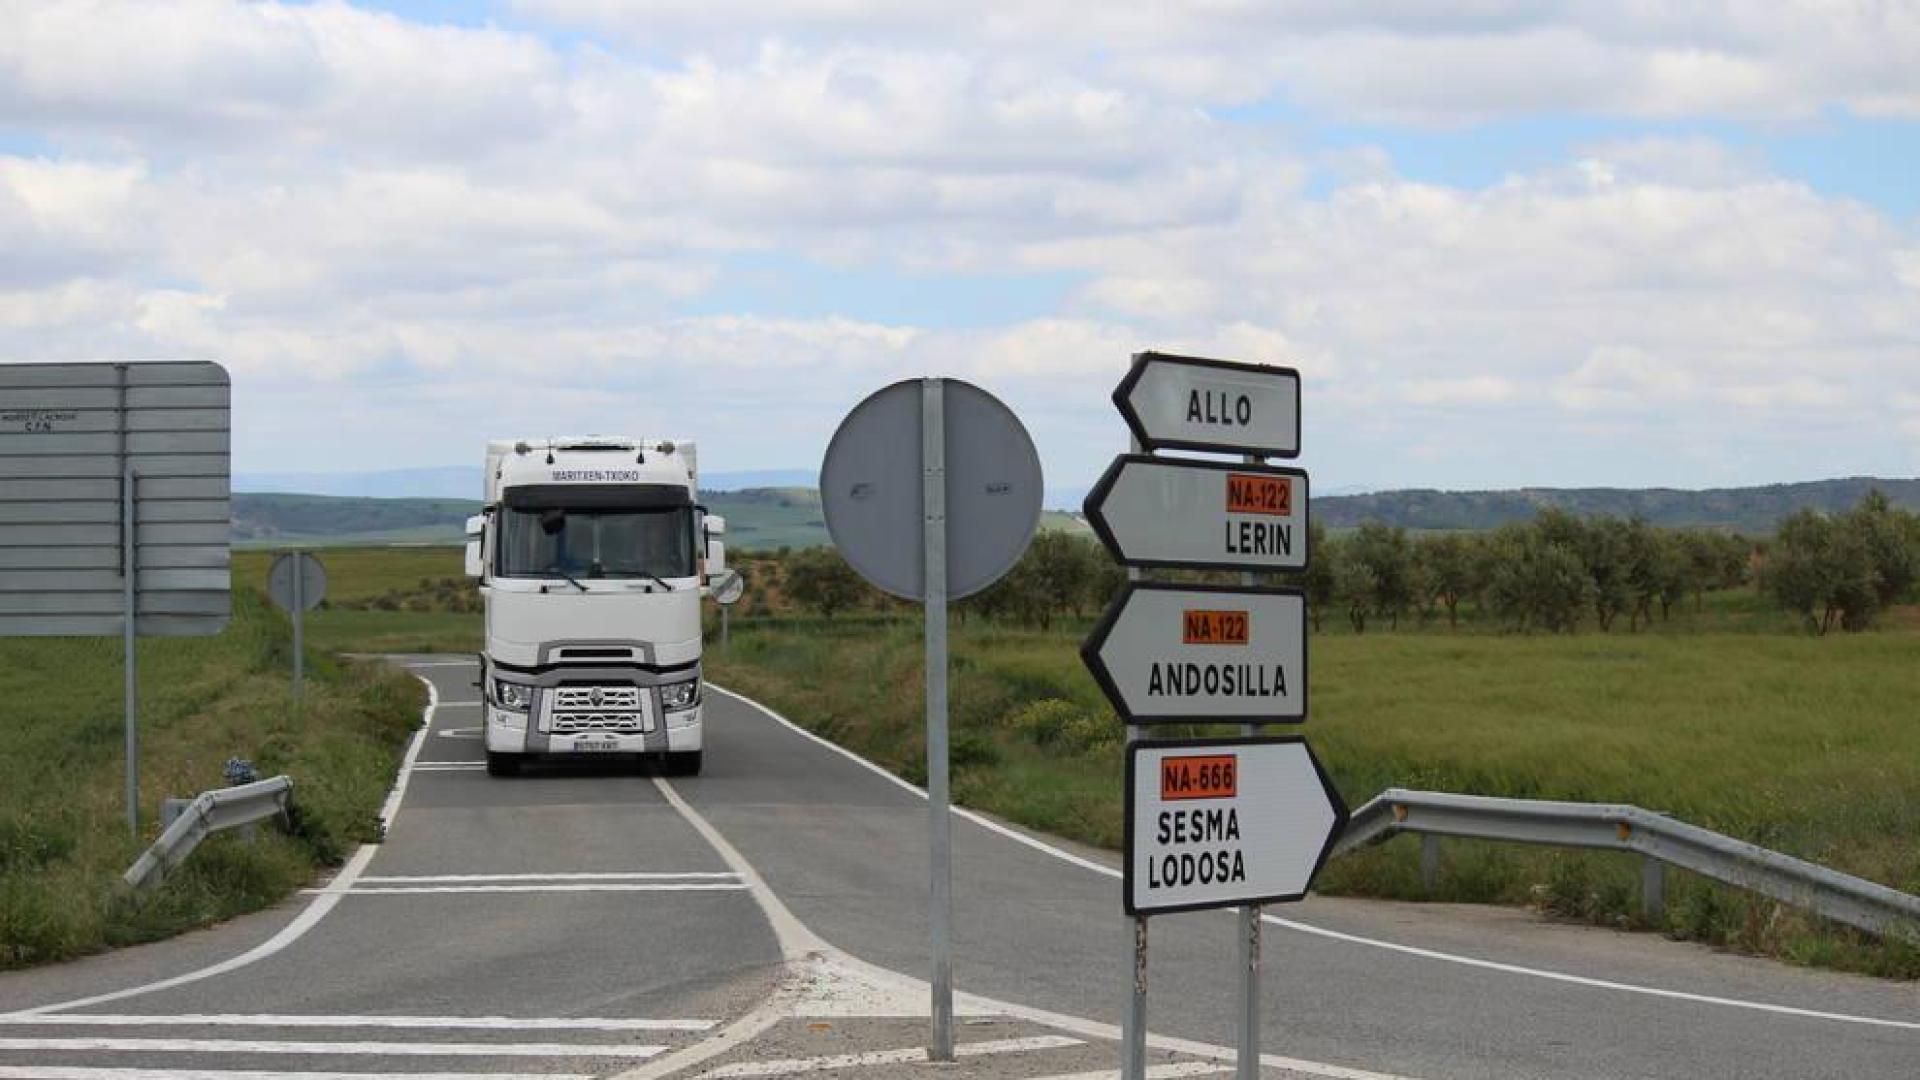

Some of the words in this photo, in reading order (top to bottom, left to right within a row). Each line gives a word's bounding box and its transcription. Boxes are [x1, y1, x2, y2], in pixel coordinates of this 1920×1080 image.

[1187, 389, 1252, 426] ALLO
[1228, 480, 1289, 509] NA-122
[1225, 521, 1291, 556] LERIN
[1187, 616, 1245, 642] NA-122
[1148, 662, 1287, 697] ANDOSILLA
[1165, 763, 1233, 793] NA-666
[1157, 808, 1240, 844] SESMA
[1149, 850, 1246, 888] LODOSA
